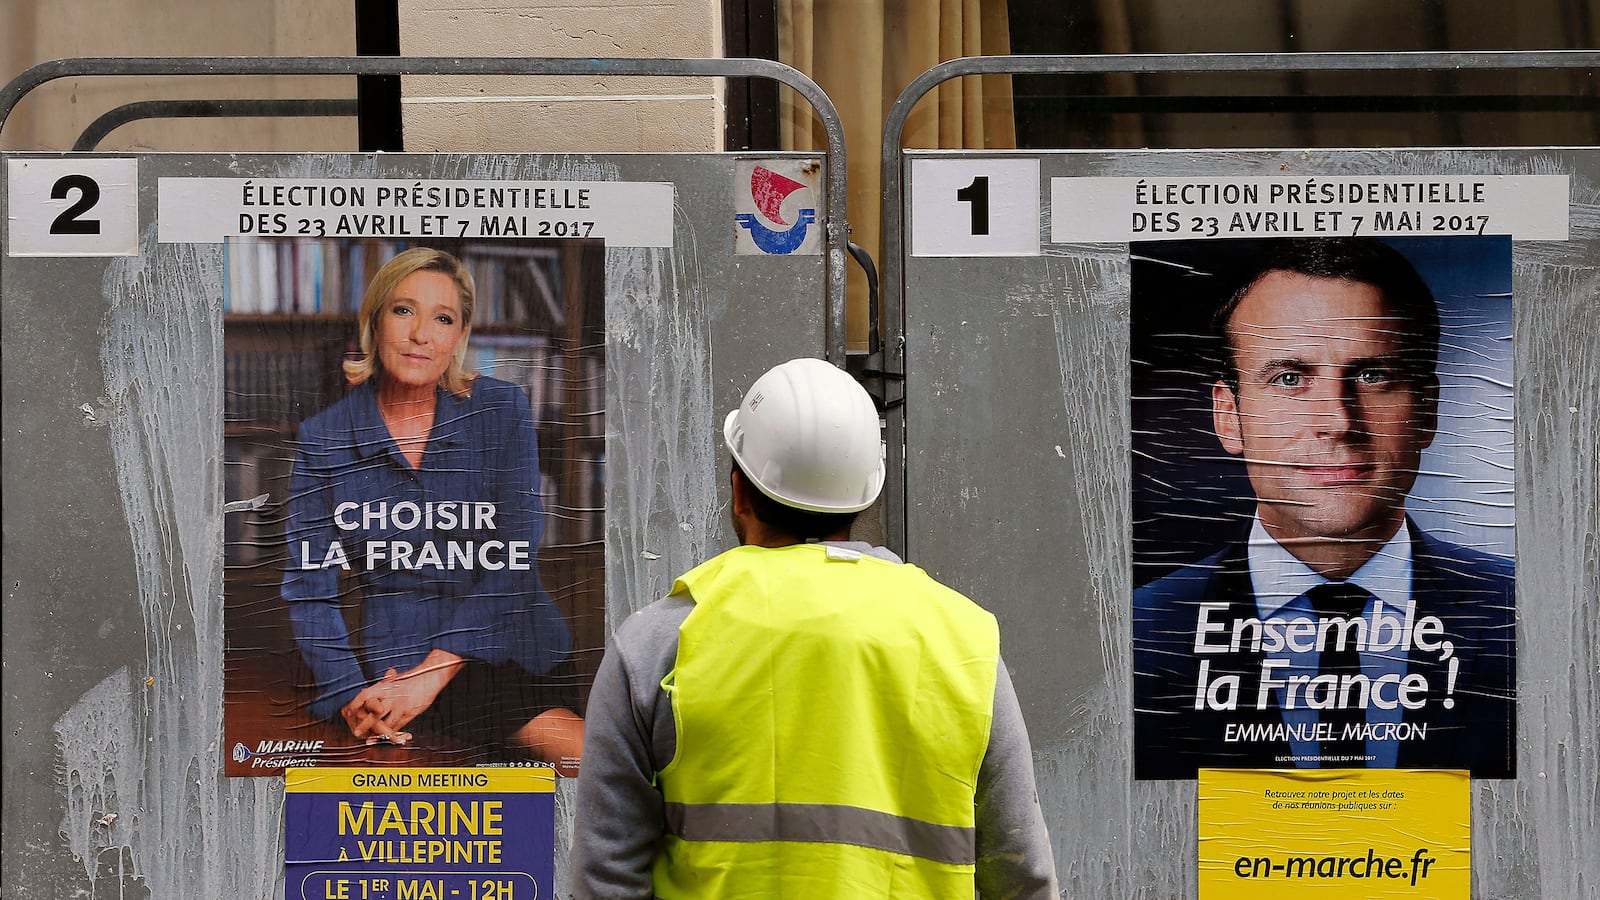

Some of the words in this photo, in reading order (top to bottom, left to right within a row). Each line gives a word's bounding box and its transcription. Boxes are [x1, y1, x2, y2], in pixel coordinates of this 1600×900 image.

[49, 175, 101, 235] 2
[242, 179, 367, 207] ÉLECTION
[377, 181, 591, 209] PRÉSIDENTIELLE
[956, 176, 990, 235] 1
[1135, 180, 1258, 206] ÉLECTION
[1270, 177, 1485, 205] PRÉSIDENTIELLE
[239, 214, 287, 234] DES
[297, 218, 326, 237] 23
[336, 214, 415, 235] AVRIL
[421, 214, 450, 235] ET
[458, 218, 469, 238] 7
[479, 216, 526, 235] MAI
[538, 218, 595, 238] 2017
[1132, 212, 1181, 233] DES
[1190, 216, 1219, 236] 23
[1229, 212, 1304, 232] AVRIL
[1314, 212, 1340, 232] ET
[1351, 215, 1363, 236] 7
[1373, 212, 1421, 232] MAI
[1432, 215, 1490, 235] 2017
[334, 502, 497, 530] CHOISIR
[301, 541, 351, 570] LA
[367, 541, 530, 570] FRANCE
[1194, 600, 1454, 660] Ensemble,
[1195, 660, 1240, 710] la
[1257, 659, 1428, 710] France
[1225, 723, 1336, 741] EMMANUEL
[1342, 723, 1427, 740] MACRON
[256, 741, 324, 752] MARINE
[353, 773, 411, 788] GRAND
[418, 773, 488, 787] MEETING
[1332, 790, 1356, 800] projet
[1338, 801, 1376, 811] publiques
[338, 801, 502, 835] MARINE
[338, 848, 348, 862] À
[358, 841, 501, 863] VILLEPINTE
[1235, 849, 1435, 886] en-marche.fr
[326, 880, 349, 900] LE
[398, 880, 444, 900] MAI
[468, 880, 512, 900] 12H
